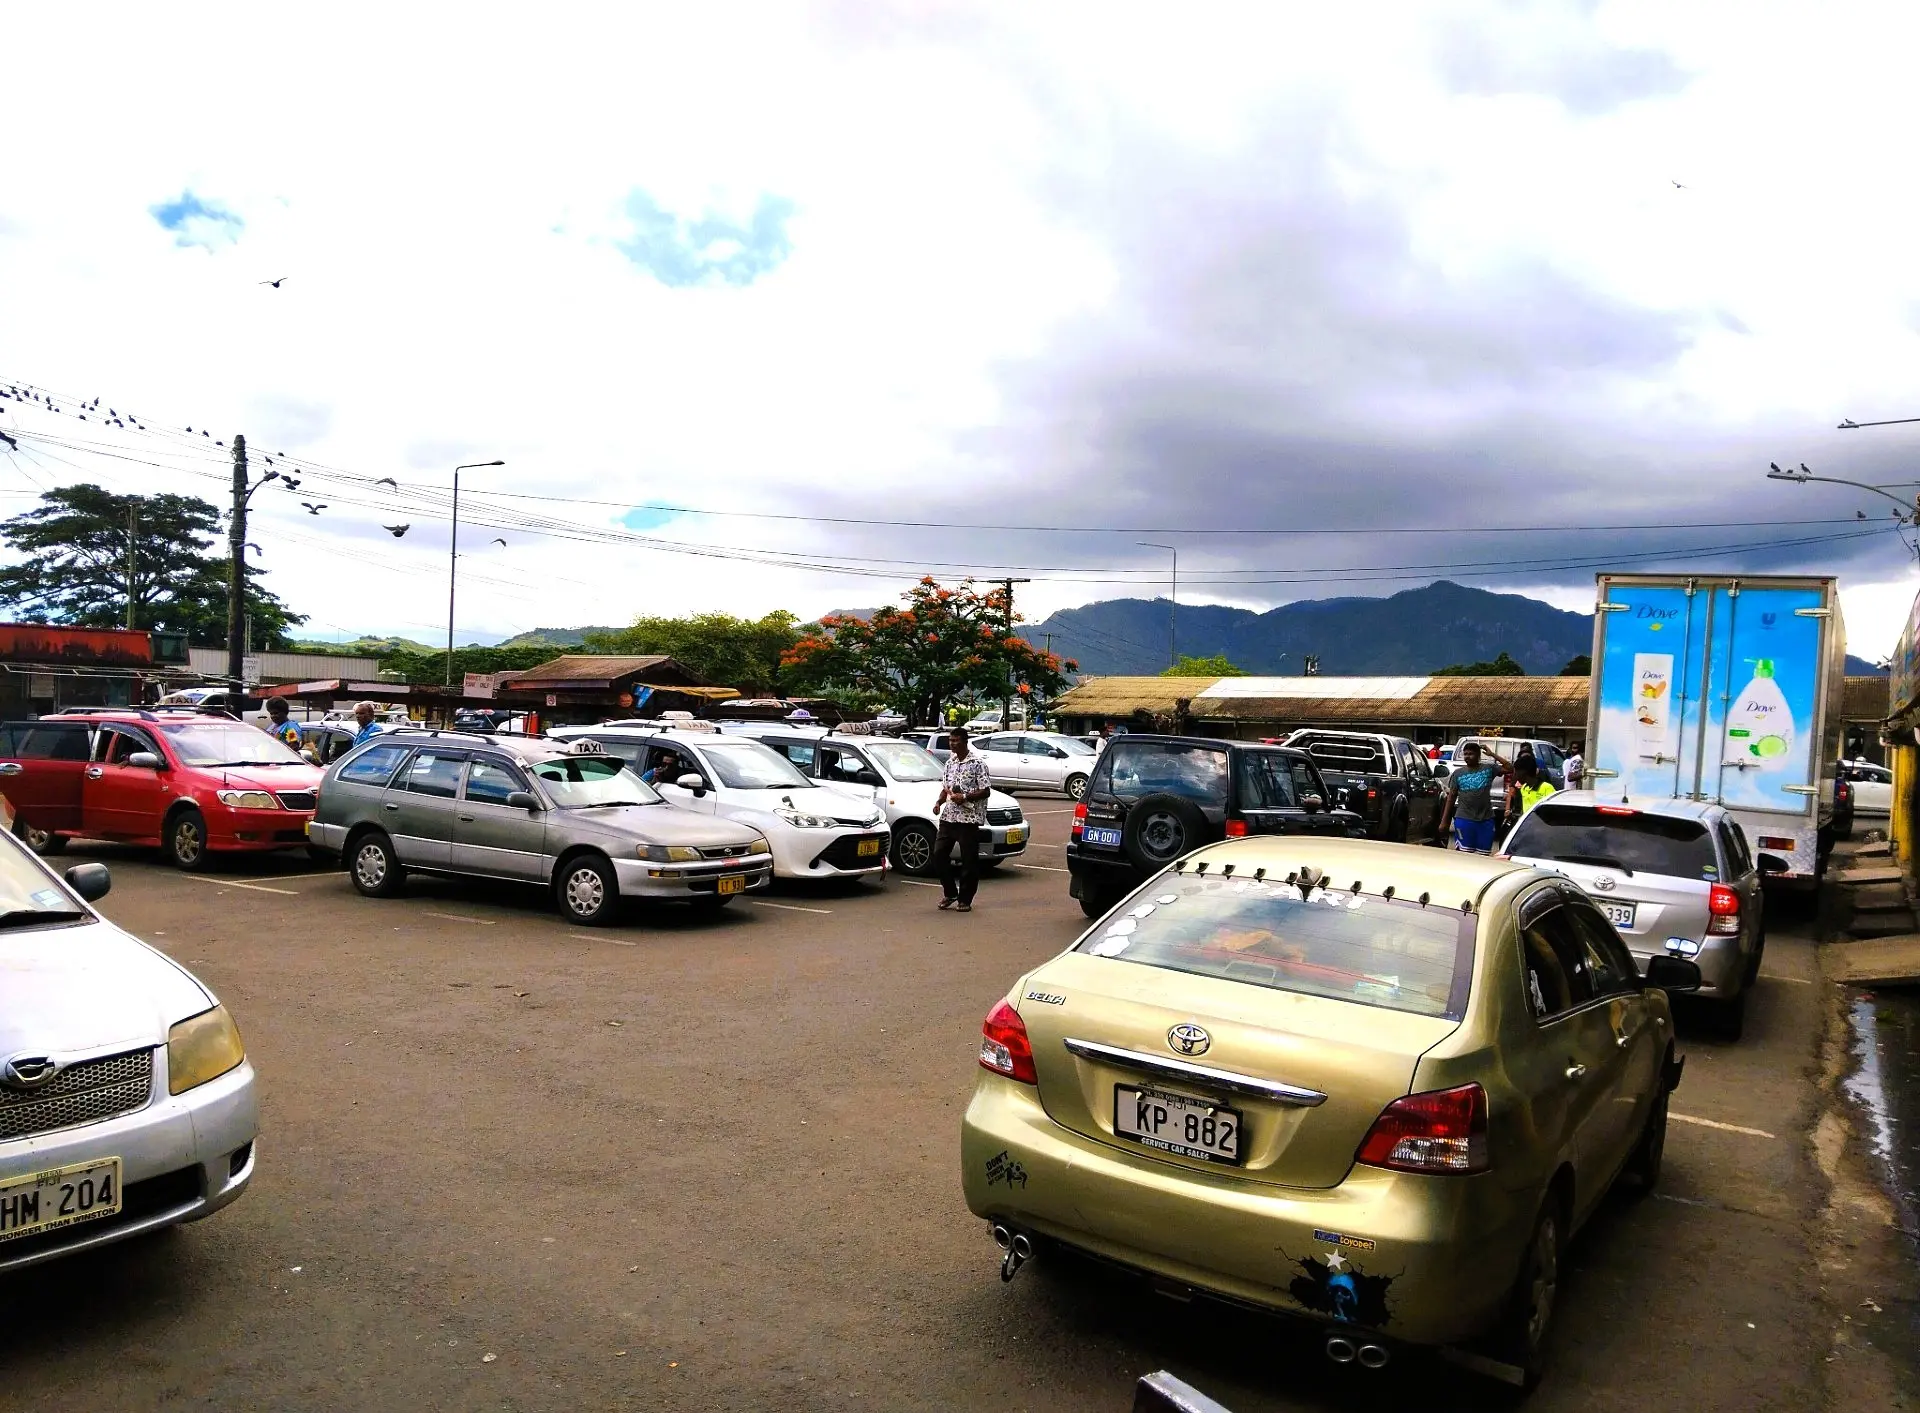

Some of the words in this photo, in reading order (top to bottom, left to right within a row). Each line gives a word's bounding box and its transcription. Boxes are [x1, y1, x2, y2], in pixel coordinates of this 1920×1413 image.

[1637, 604, 1678, 619] Dove
[1642, 671, 1664, 679] Dove
[1746, 701, 1777, 713] Dove
[849, 724, 869, 733] TAXI
[577, 743, 602, 752] TAXI
[1087, 829, 1117, 843] GN-001
[1166, 1100, 1187, 1111] FIJI
[1140, 1136, 1170, 1151] SERVICE
[1170, 1143, 1186, 1155] CAR
[1186, 1148, 1210, 1161] SALES
[44, 1218, 71, 1231] THAN
[72, 1207, 116, 1223] WINSTON
